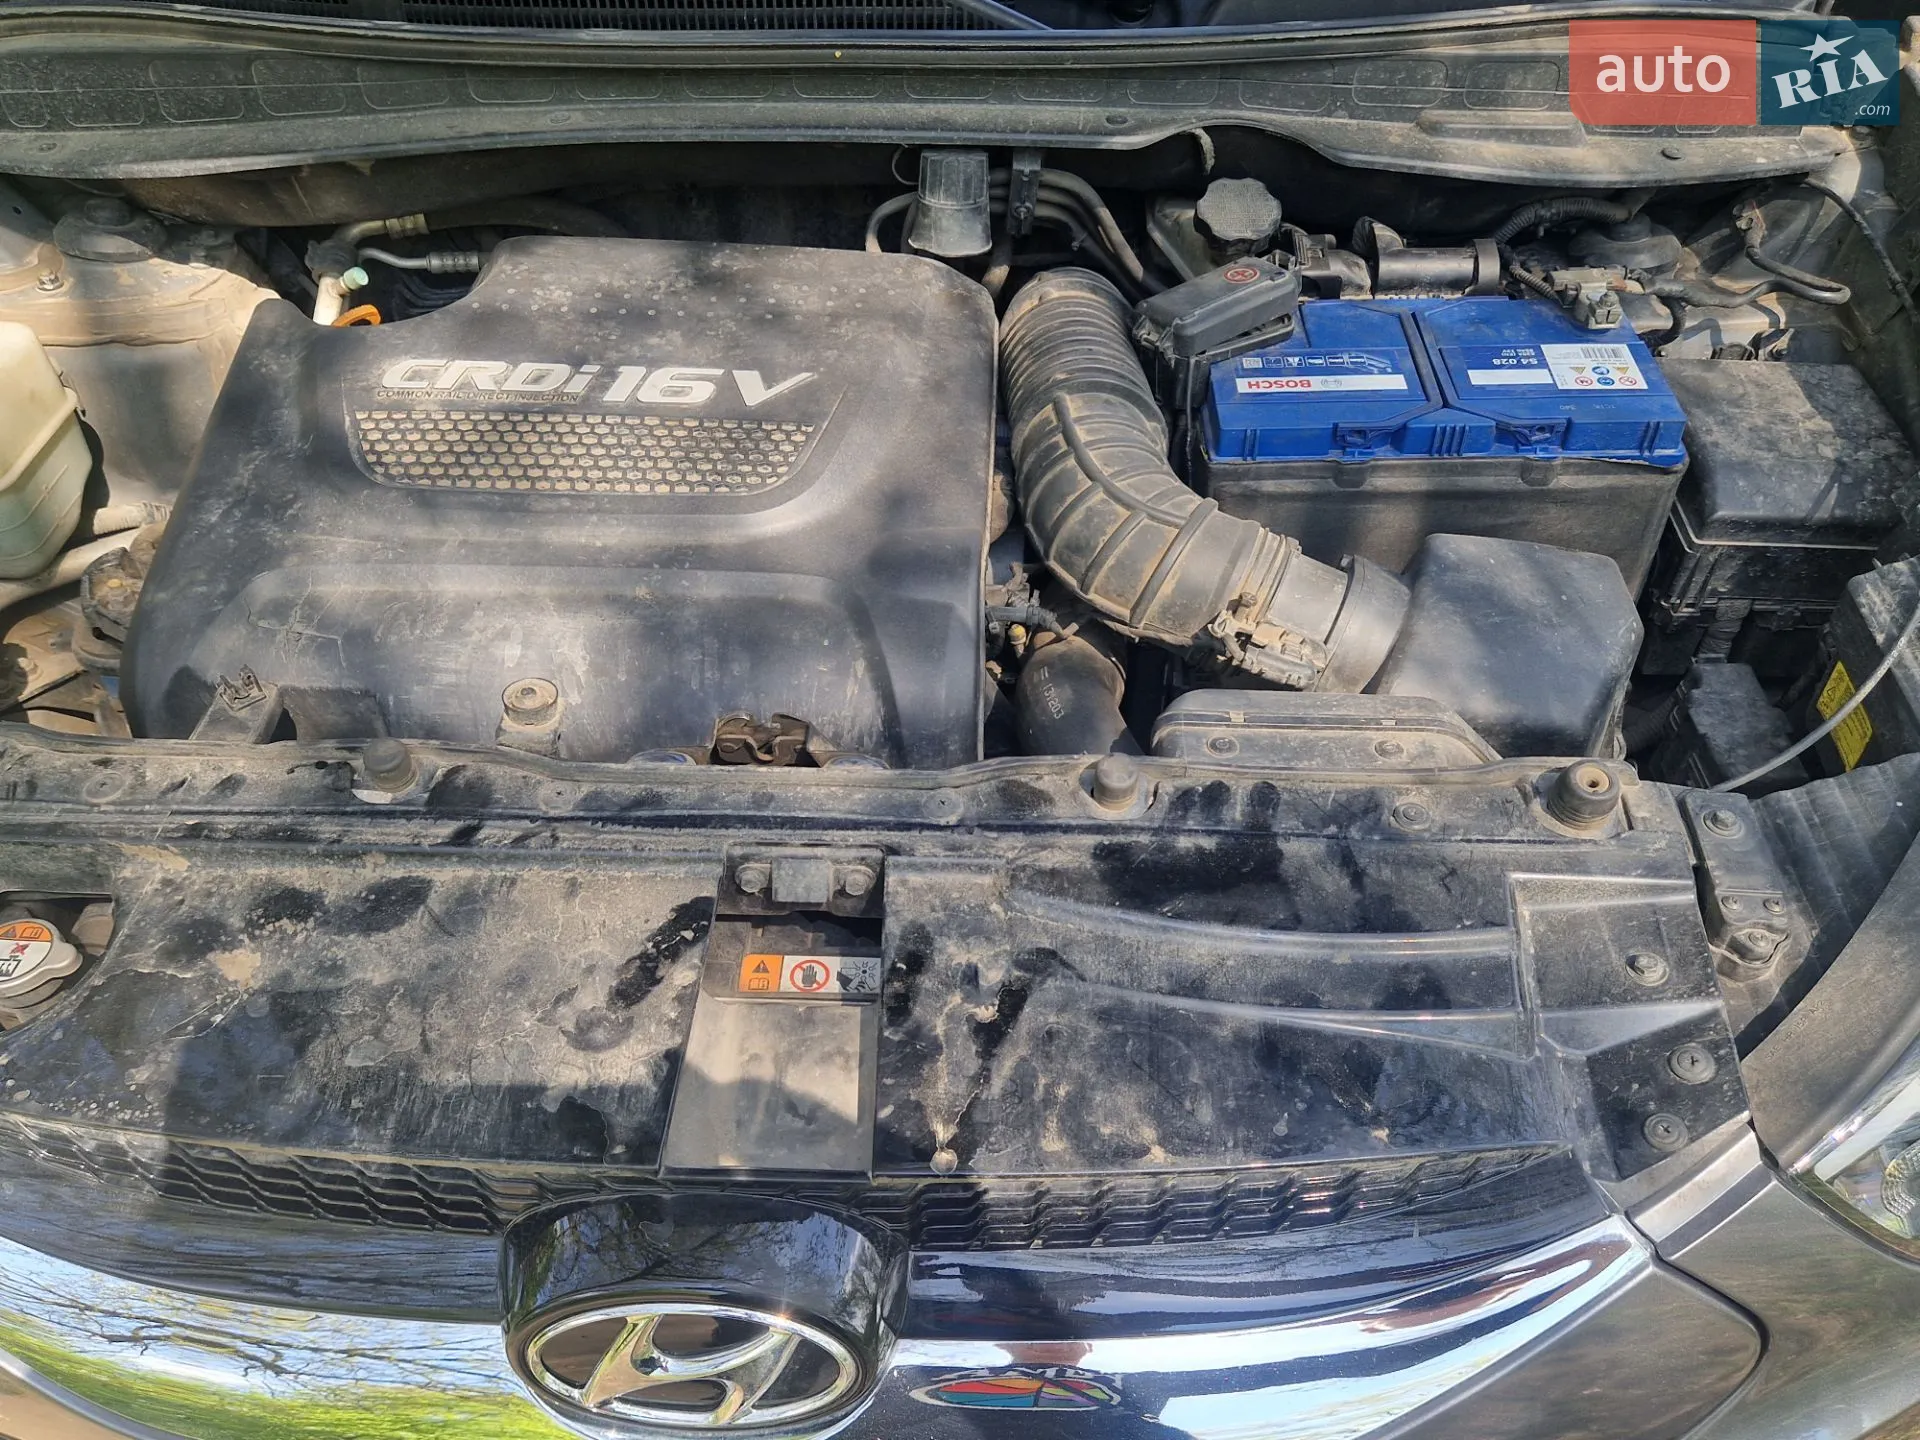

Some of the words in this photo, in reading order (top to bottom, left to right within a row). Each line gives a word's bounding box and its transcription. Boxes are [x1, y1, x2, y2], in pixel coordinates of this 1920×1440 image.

[1492, 358, 1518, 366] 028
[381, 359, 601, 393] CRDi
[1247, 379, 1313, 390] BOSCH
[377, 390, 433, 399] COMMON
[512, 392, 580, 403] INJECTION
